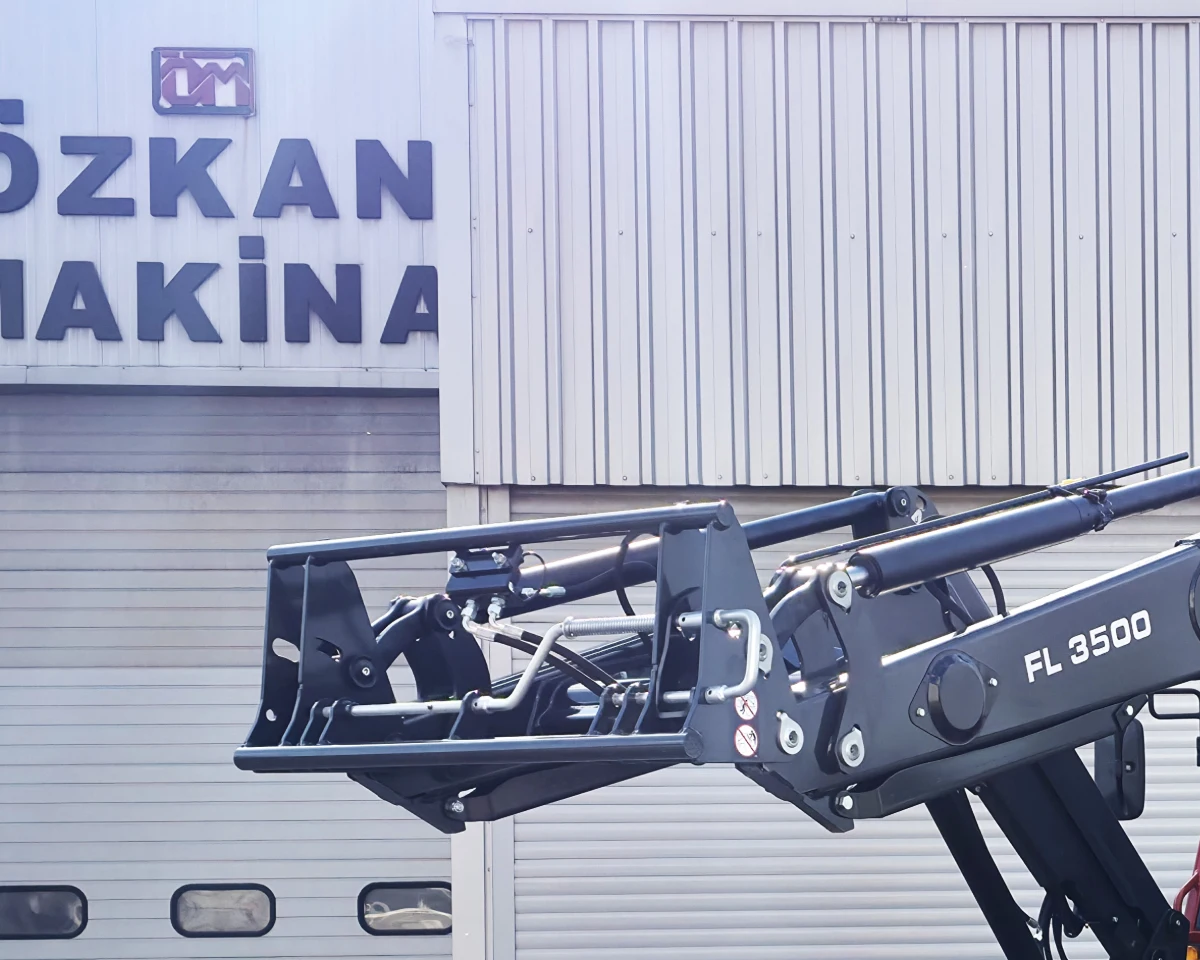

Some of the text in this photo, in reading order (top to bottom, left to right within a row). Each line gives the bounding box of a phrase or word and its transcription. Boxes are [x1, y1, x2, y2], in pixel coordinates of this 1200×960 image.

[0, 236, 438, 344] AKİNA
[1024, 609, 1152, 683] FL 3500
